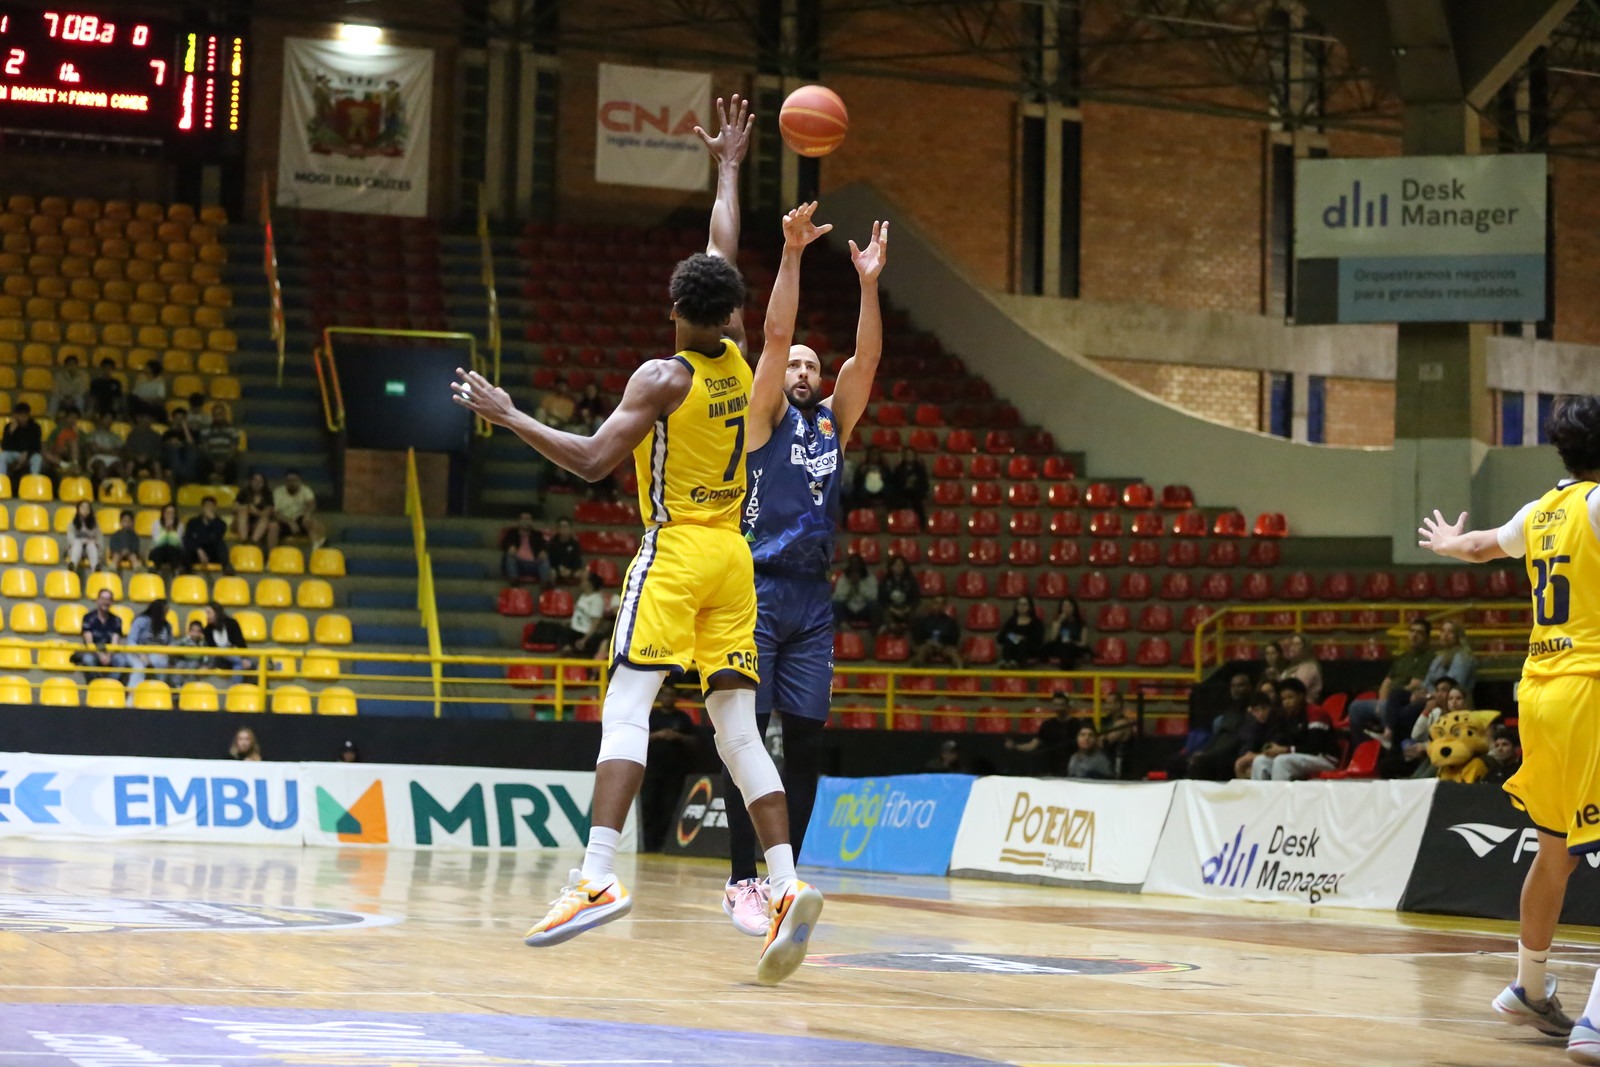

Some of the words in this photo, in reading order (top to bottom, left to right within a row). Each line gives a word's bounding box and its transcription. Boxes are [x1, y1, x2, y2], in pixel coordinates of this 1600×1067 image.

[132, 25, 148, 46] 0
[5, 48, 25, 75] 2
[150, 60, 166, 86] 7
[600, 101, 700, 136] CNA
[335, 174, 361, 187] DAS
[1402, 178, 1466, 201] Desk
[1402, 204, 1519, 233] Manager
[1354, 268, 1451, 282] Orquestramos
[1354, 289, 1386, 302] para
[1388, 287, 1443, 302] grandes
[709, 401, 726, 418] DANI
[723, 415, 745, 482] 7
[114, 775, 298, 830] EMBU
[1267, 825, 1320, 858] Desk
[1256, 860, 1345, 904] Manager
